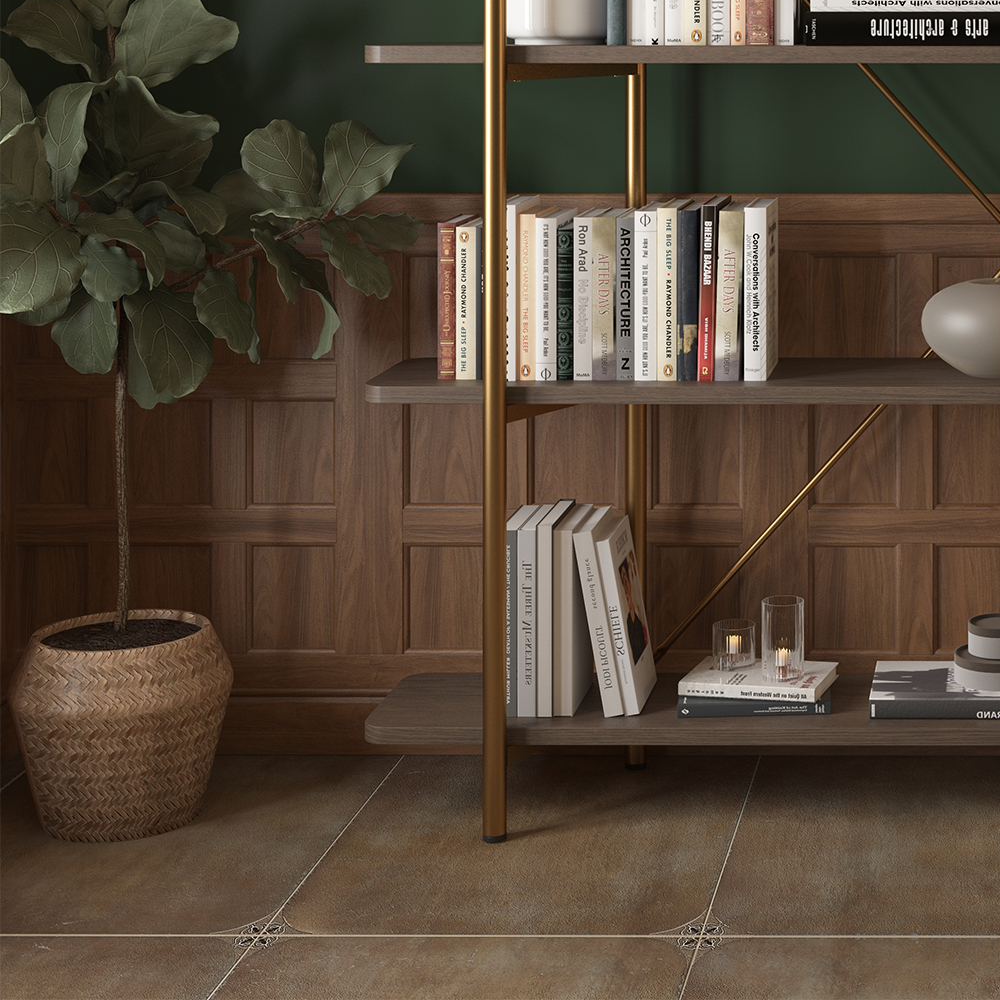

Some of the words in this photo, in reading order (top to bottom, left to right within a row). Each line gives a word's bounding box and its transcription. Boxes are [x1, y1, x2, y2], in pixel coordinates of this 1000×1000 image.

[870, 18, 944, 40] architecture
[964, 18, 988, 39] arts
[577, 224, 588, 245] Ron
[702, 220, 712, 251] BHENDI
[577, 247, 588, 272] Arad
[597, 252, 610, 288] AFTER
[702, 253, 714, 286] BAZAAR
[723, 248, 736, 284] AFTER
[752, 232, 760, 290] Conversations
[620, 227, 630, 337] ARCHITECTURE
[596, 289, 610, 316] DAYS
[721, 283, 735, 313] DAYS
[752, 310, 760, 351] Architects
[722, 349, 732, 376] MEDBURY
